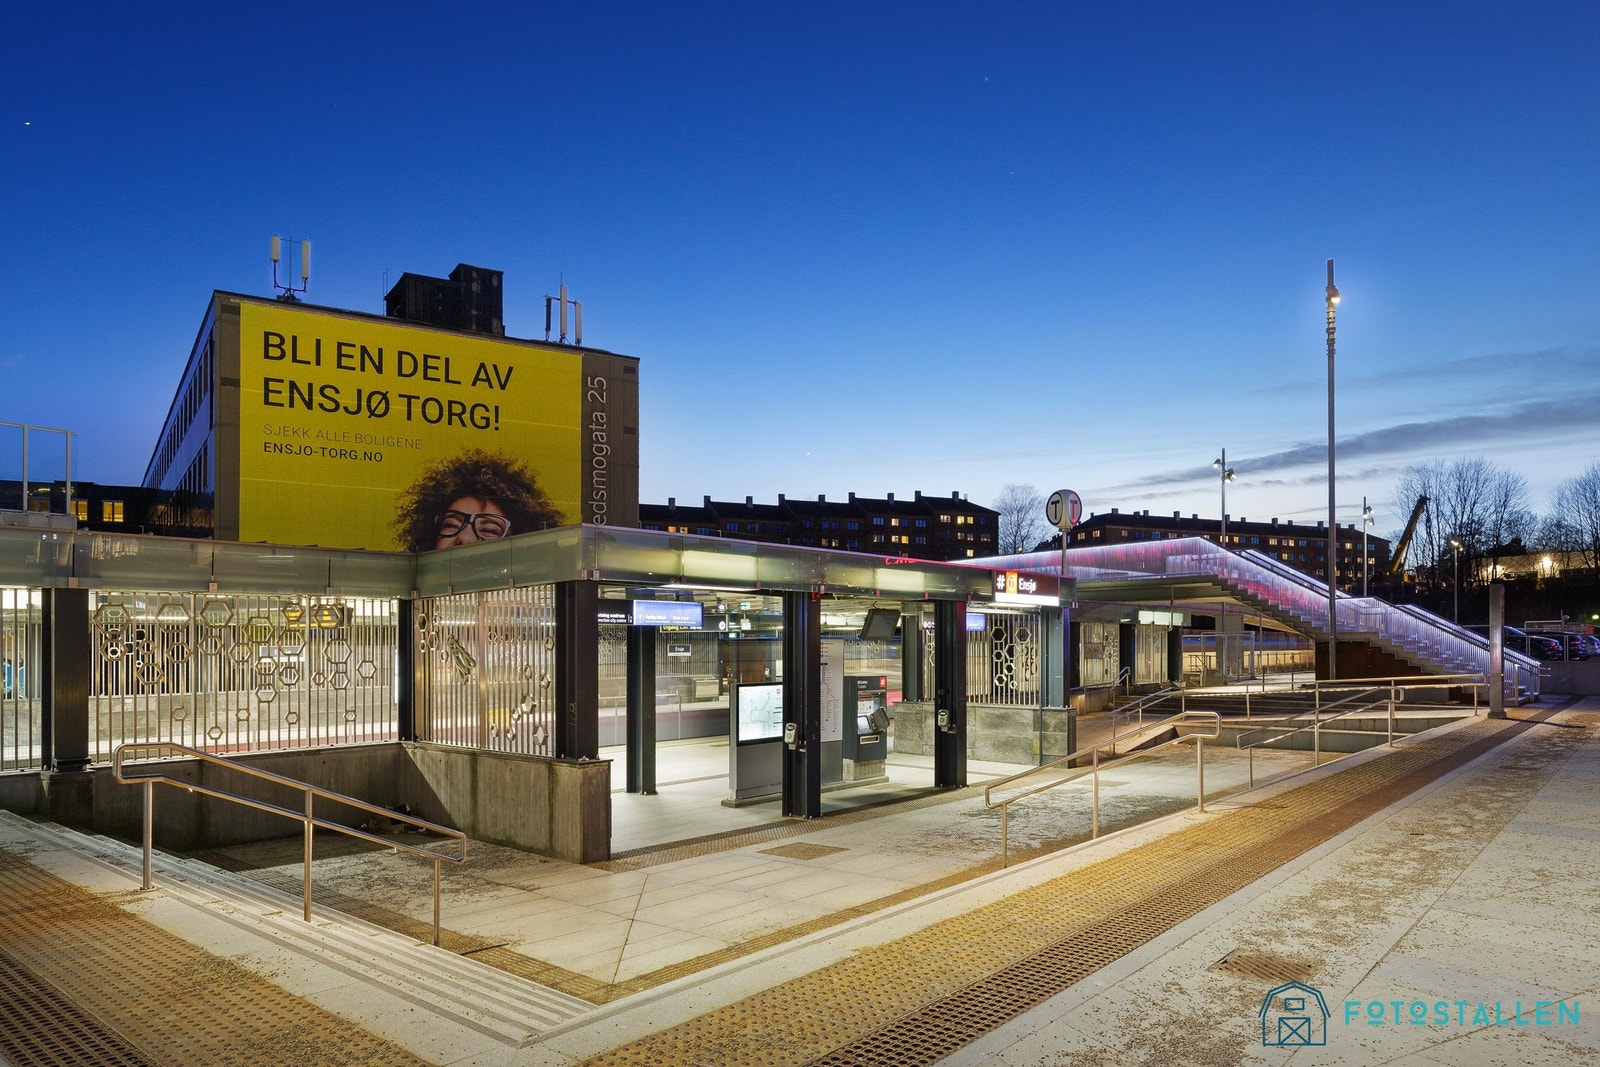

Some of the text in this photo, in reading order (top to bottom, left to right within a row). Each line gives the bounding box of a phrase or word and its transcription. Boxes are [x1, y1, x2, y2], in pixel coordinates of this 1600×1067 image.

[263, 331, 514, 390] BLI EN DEL AV
[587, 376, 607, 404] 25
[263, 377, 500, 431] ENSJØ TORG!
[263, 424, 422, 449] SJEKK ALLE BOLIGENE
[263, 441, 383, 462] ENSJO-TORG.NO
[1019, 578, 1036, 593] Ensjø
